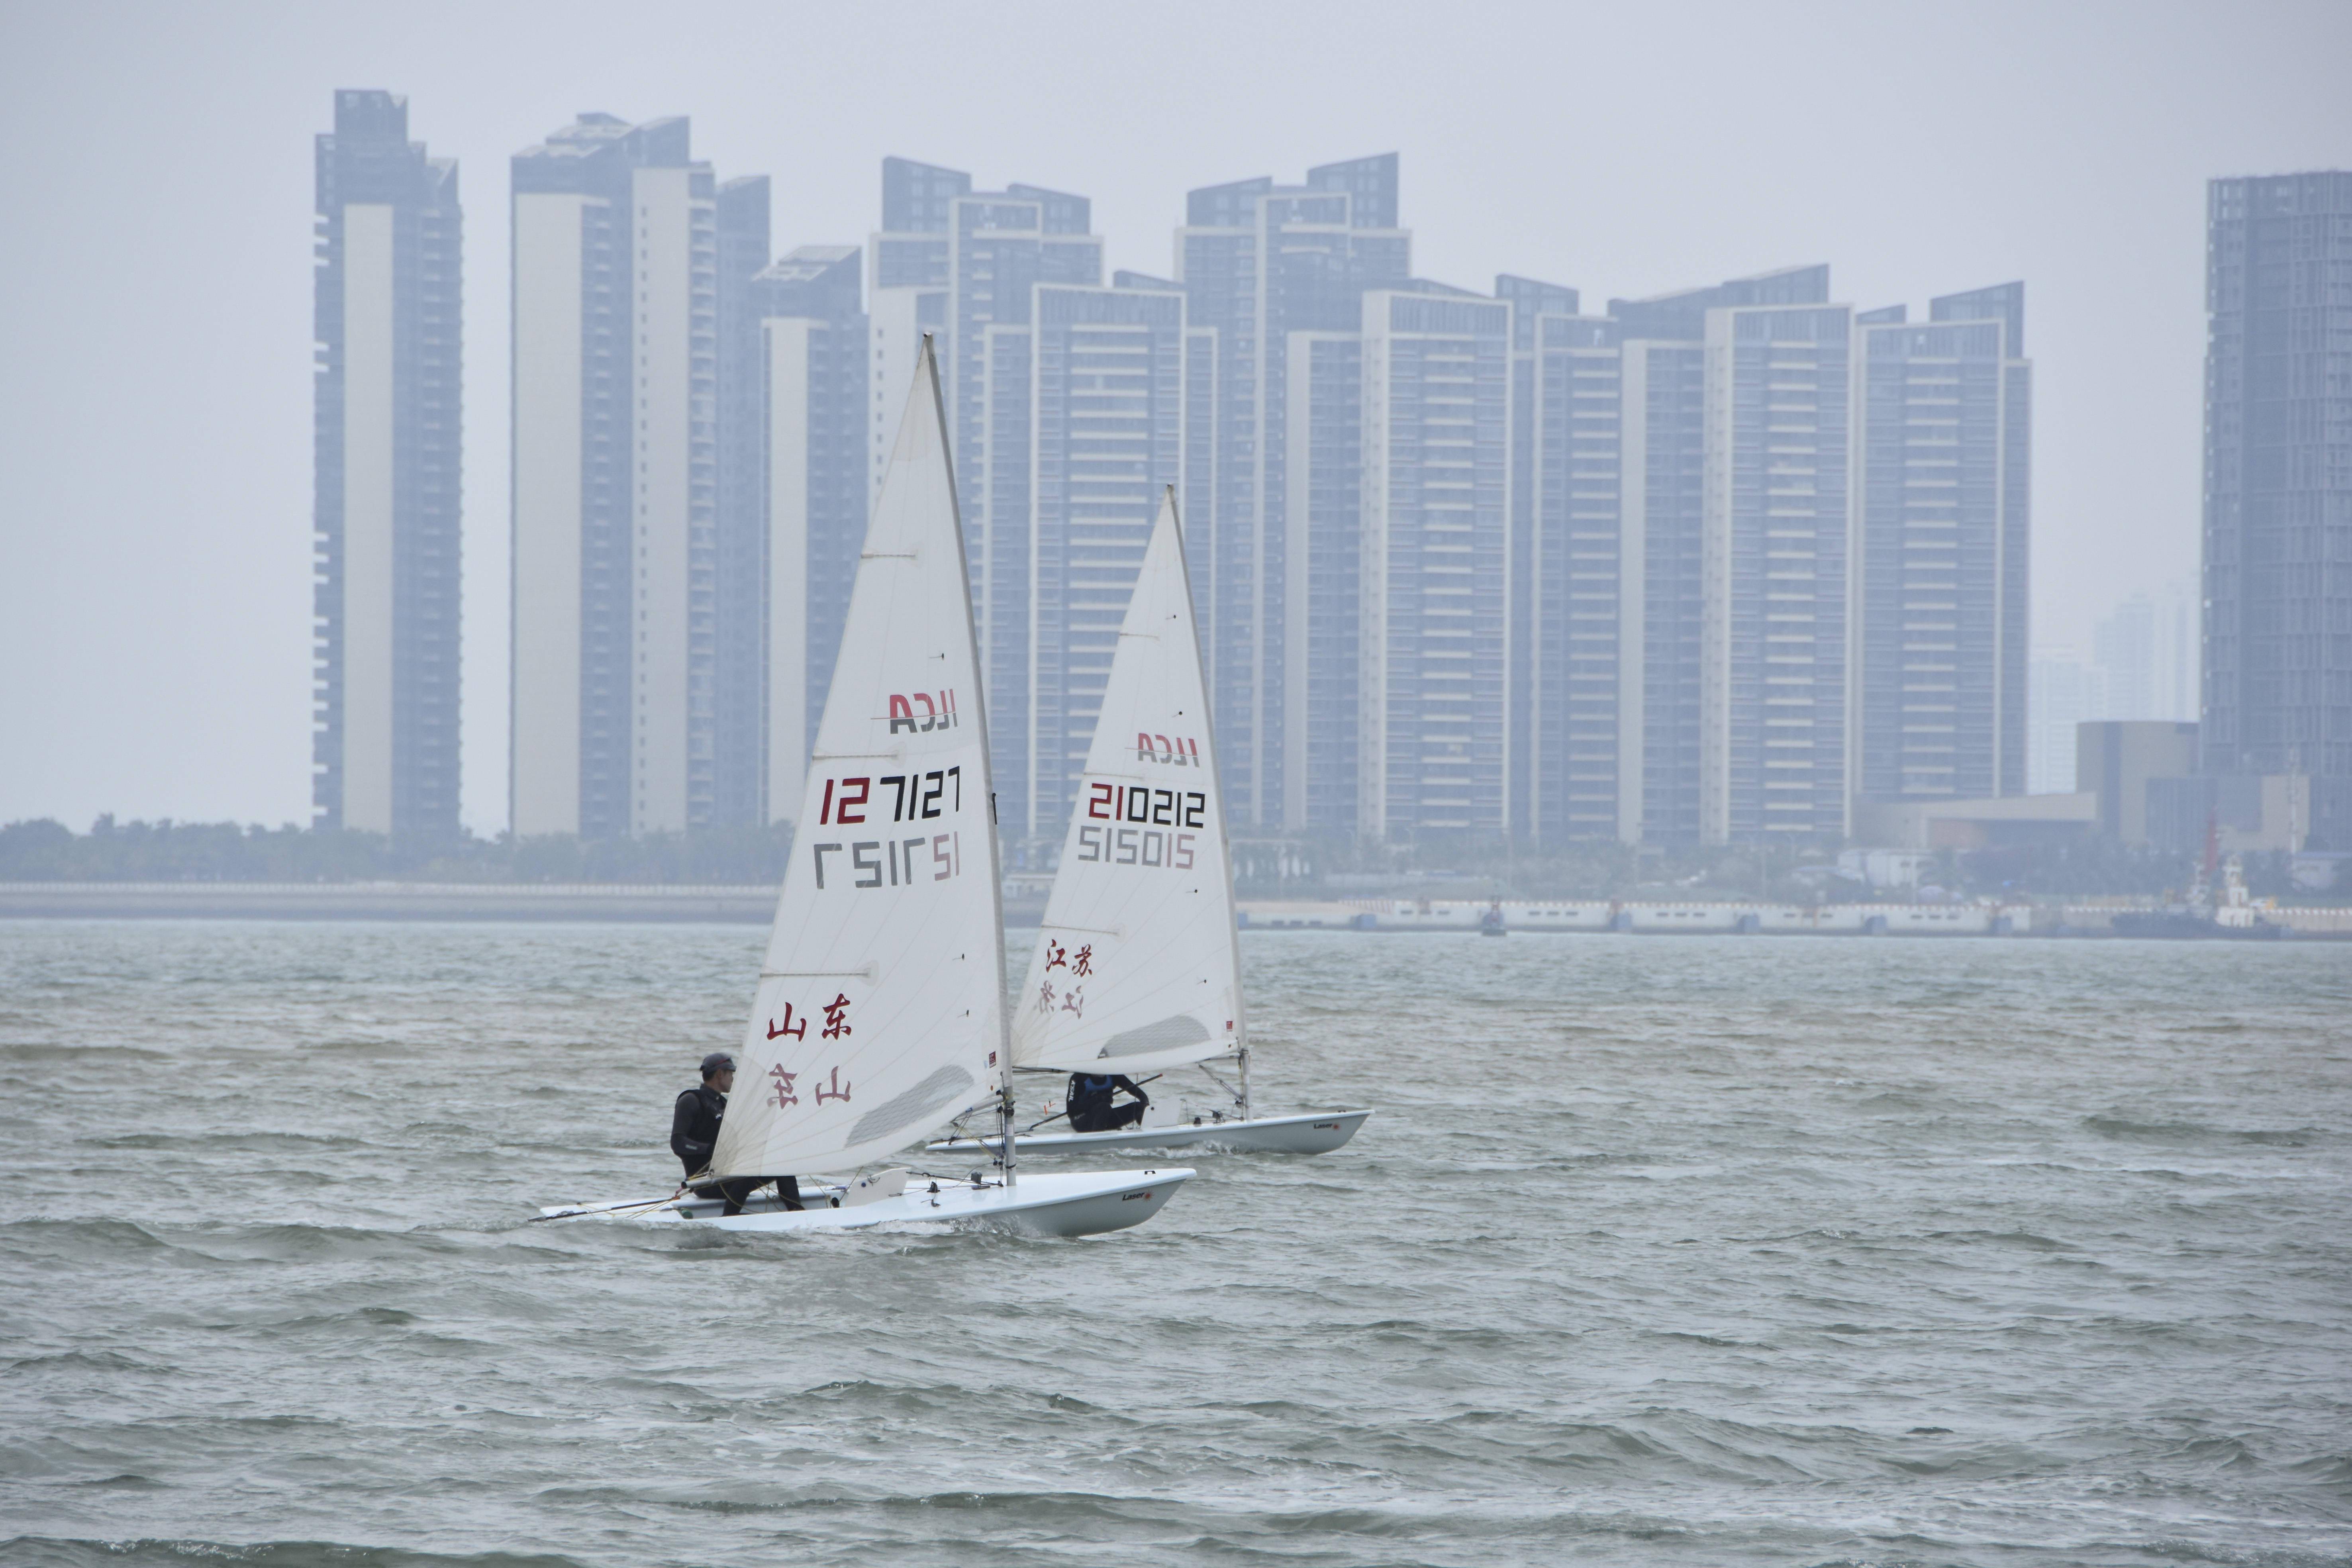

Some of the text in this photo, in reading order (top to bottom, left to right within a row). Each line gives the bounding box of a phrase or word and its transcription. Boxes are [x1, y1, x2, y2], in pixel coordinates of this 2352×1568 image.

[1089, 783, 1205, 829] 210212
[1046, 939, 1092, 978] 江苏
[766, 994, 852, 1042] 山东
[1122, 1192, 1145, 1201] Laser
